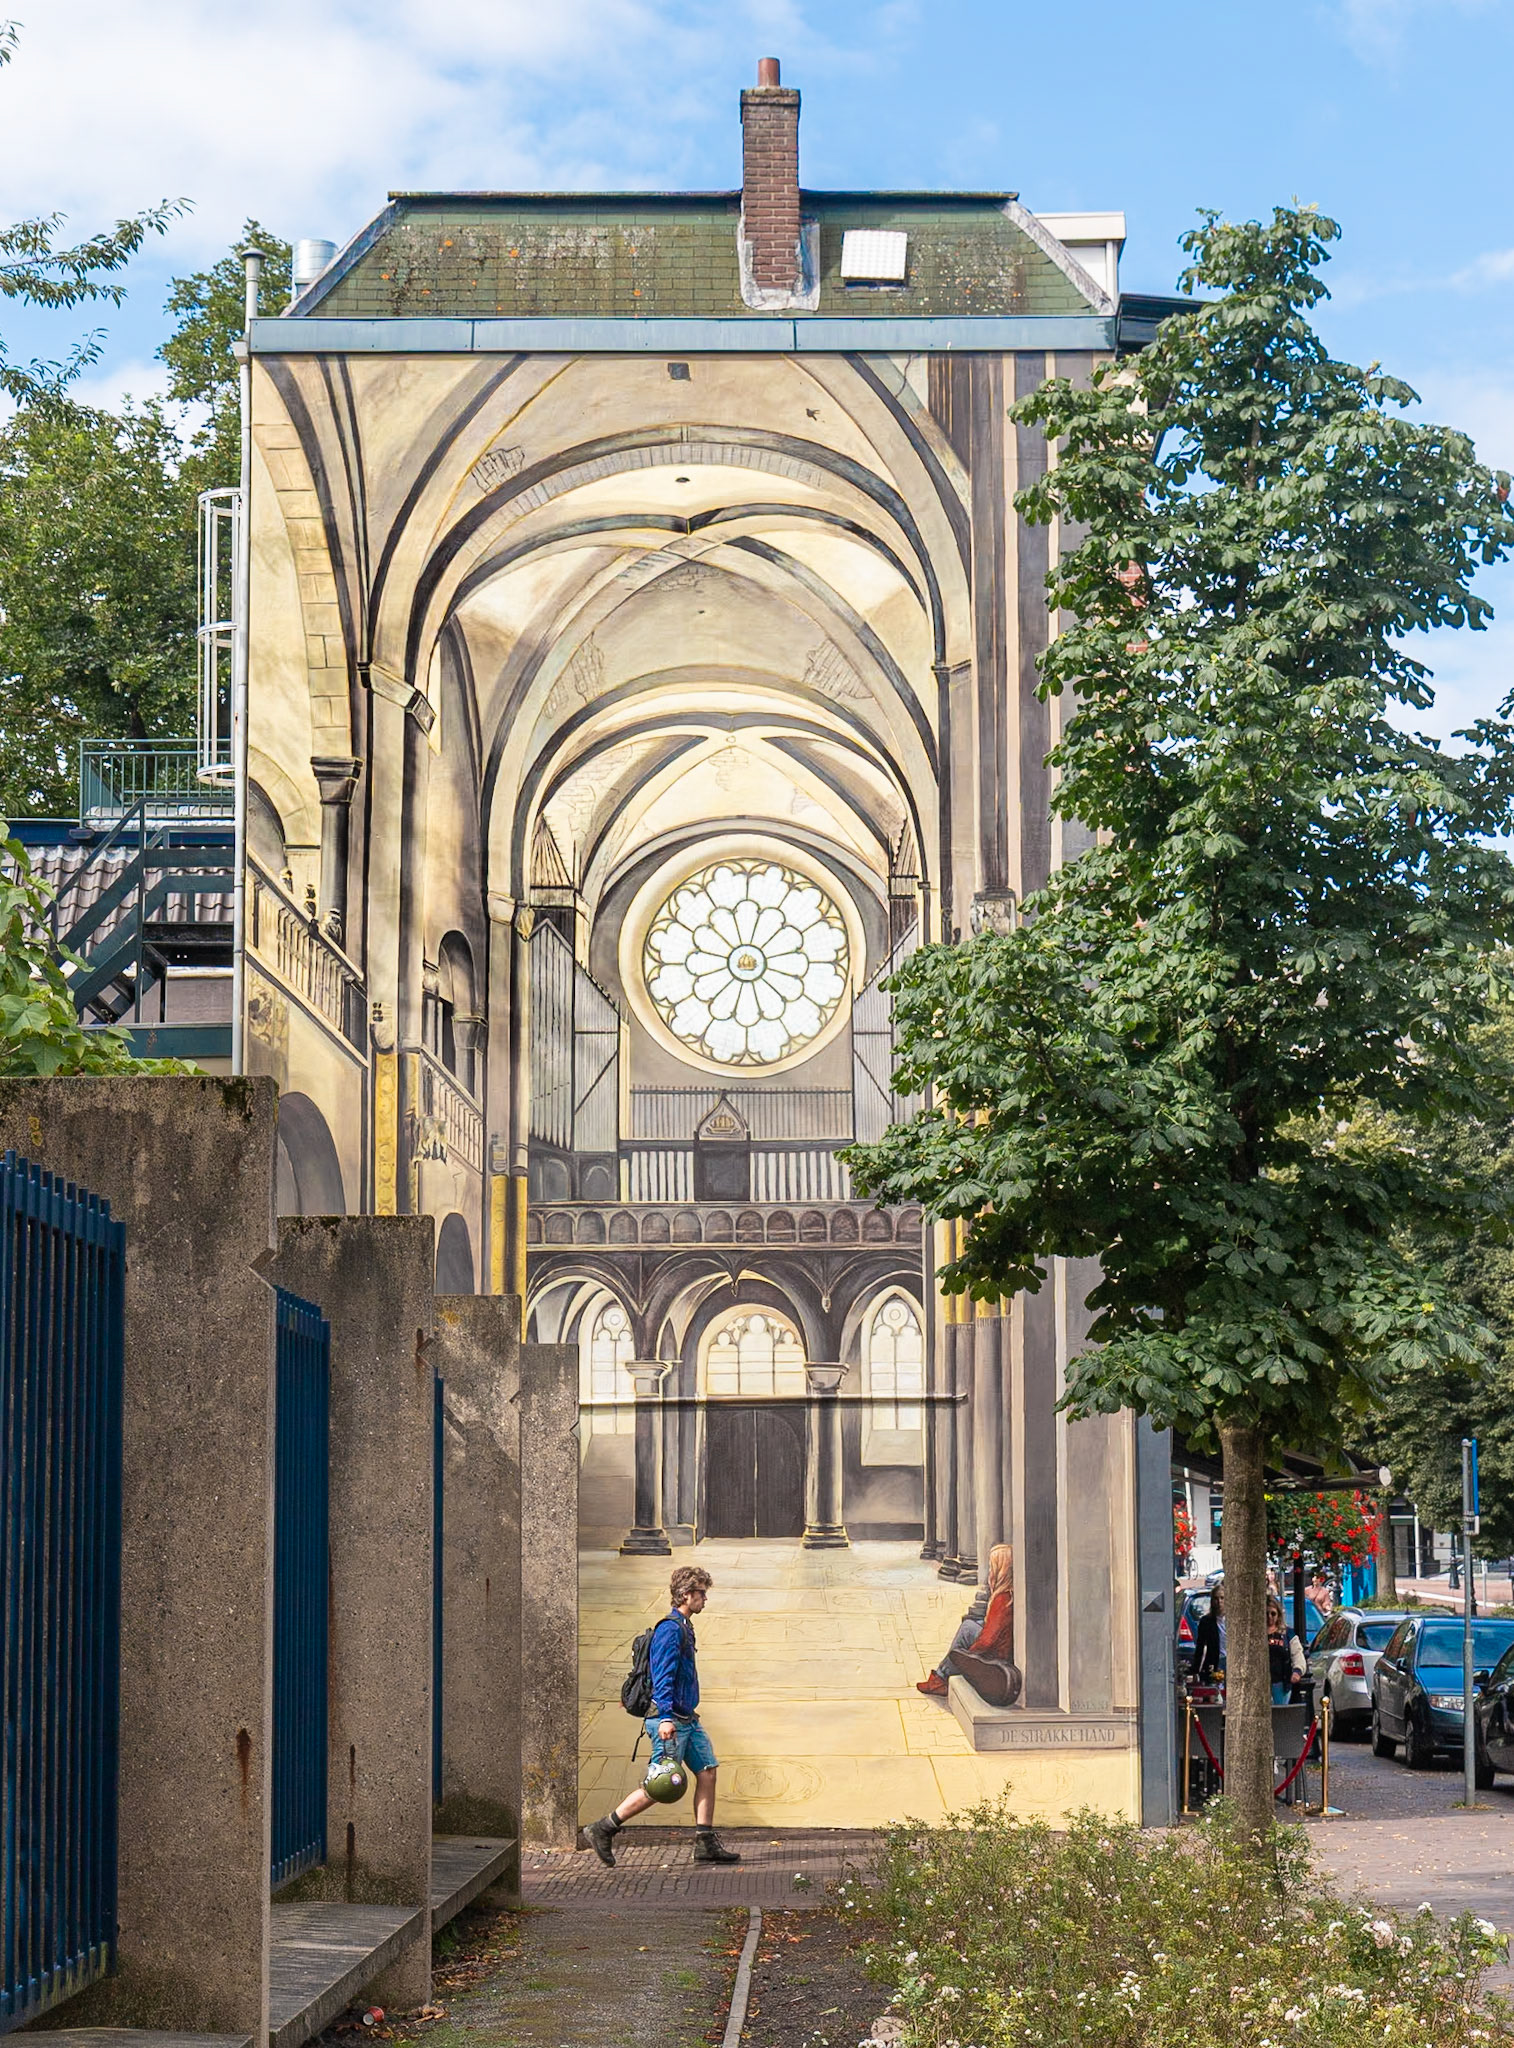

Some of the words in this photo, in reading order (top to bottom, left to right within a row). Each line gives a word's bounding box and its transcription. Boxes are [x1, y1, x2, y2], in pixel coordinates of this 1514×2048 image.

[1001, 1729, 1017, 1744] DE
[1021, 1728, 1076, 1744] STRAKKE
[1080, 1728, 1115, 1742] HAND
